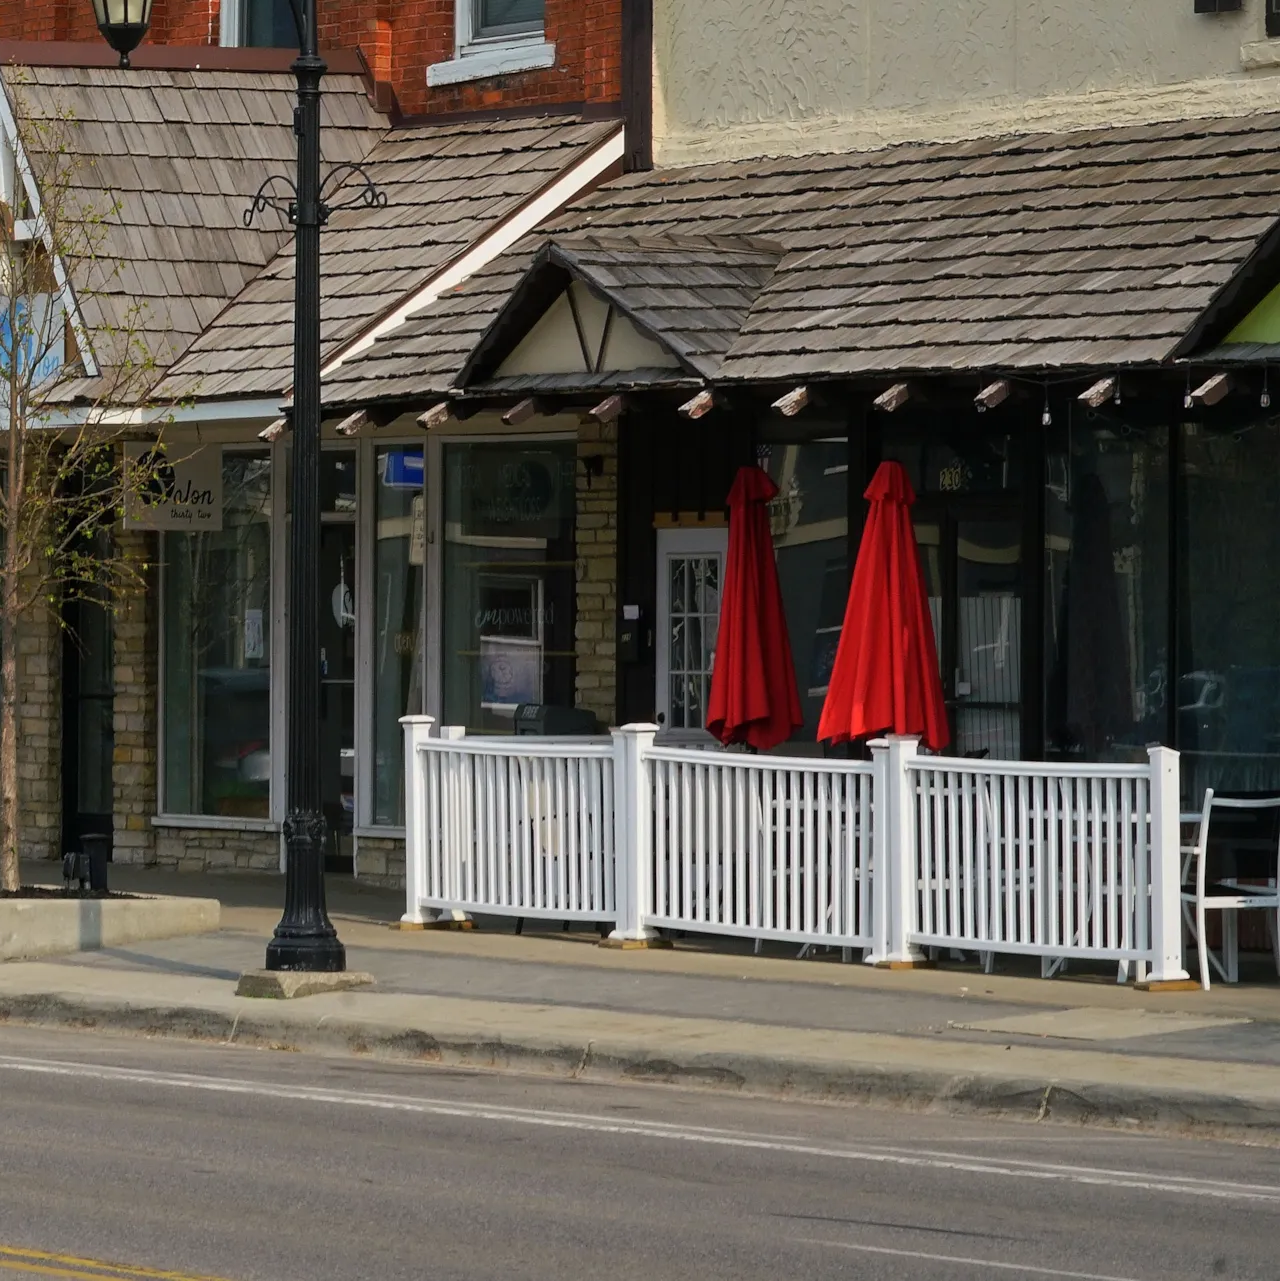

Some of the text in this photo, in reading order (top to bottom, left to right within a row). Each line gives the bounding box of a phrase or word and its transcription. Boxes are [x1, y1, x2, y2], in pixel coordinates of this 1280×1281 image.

[170, 508, 212, 524] thirty two
[522, 705, 539, 719] FREE
